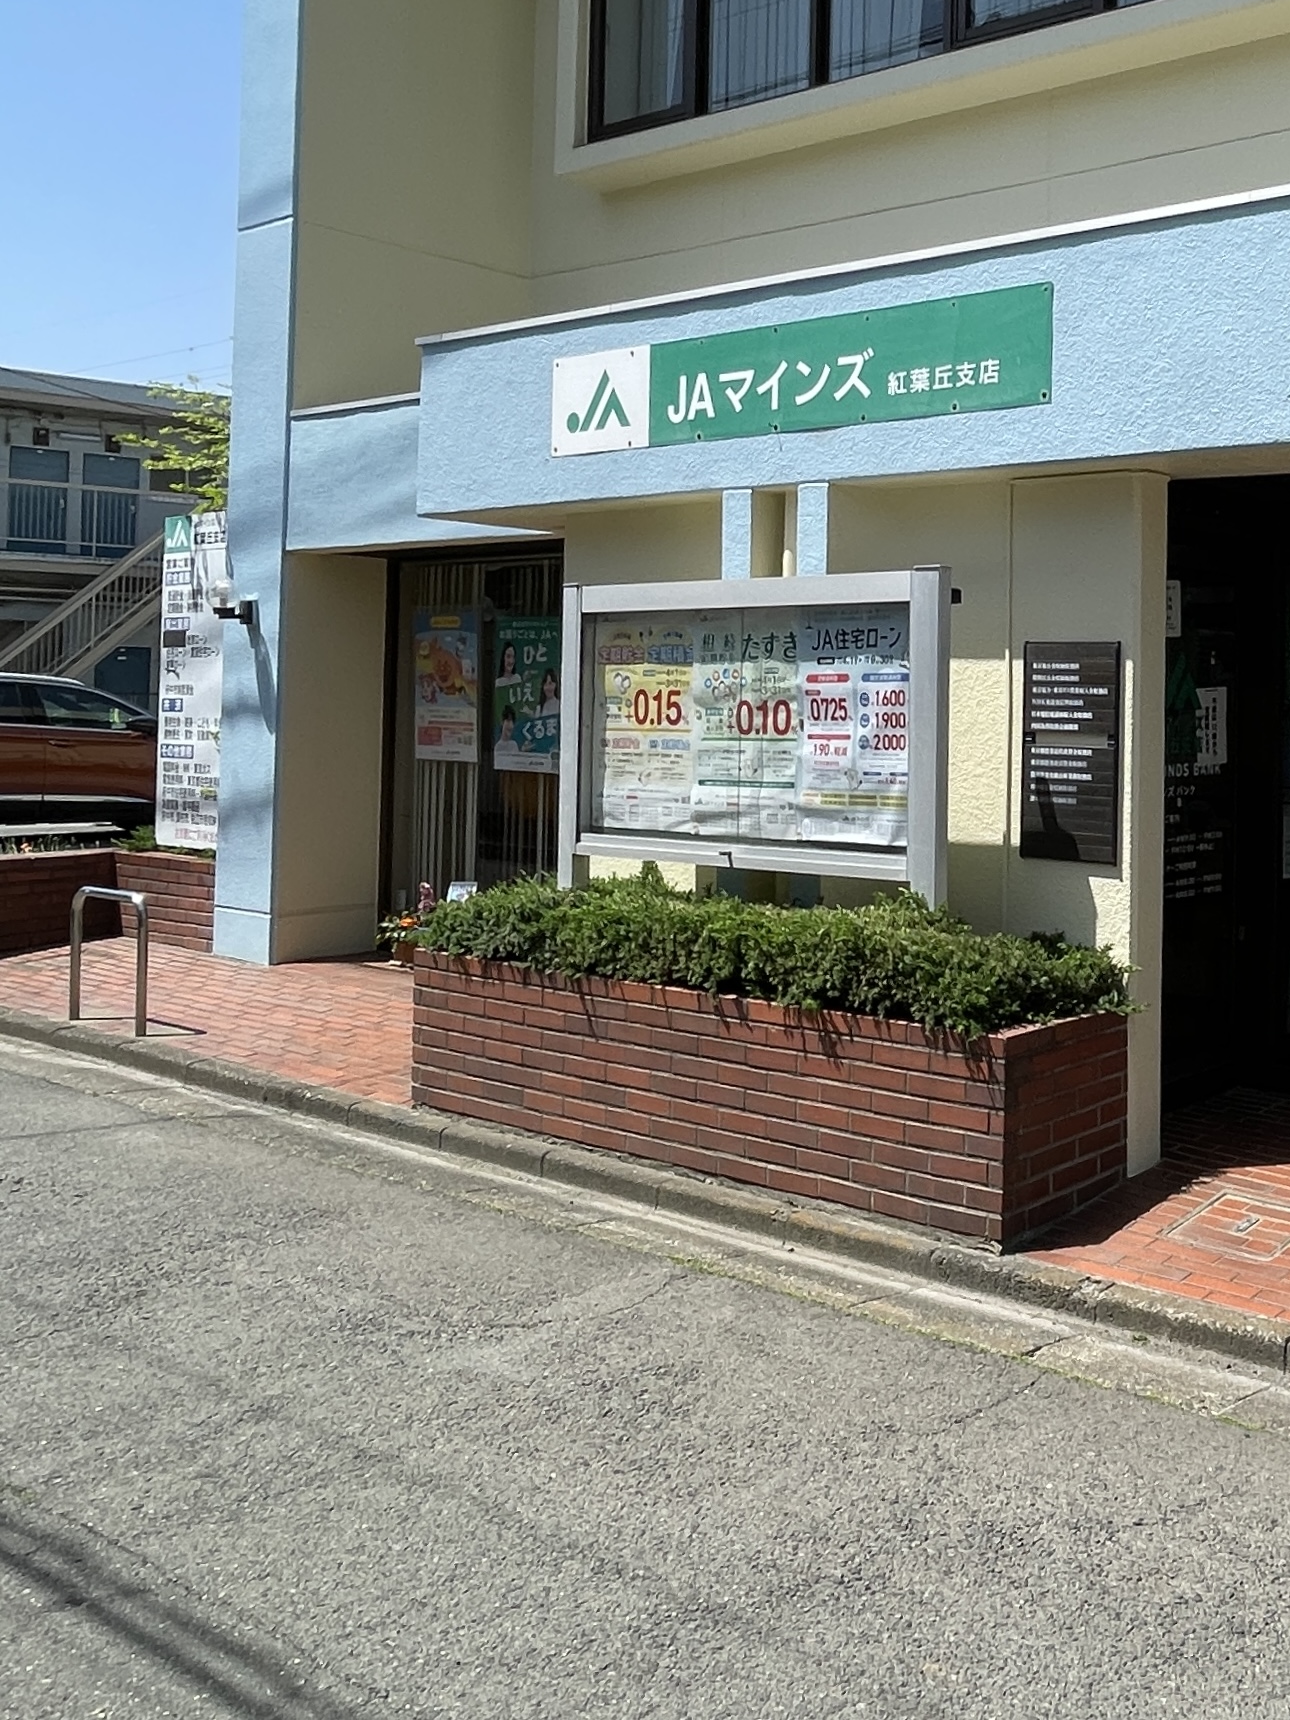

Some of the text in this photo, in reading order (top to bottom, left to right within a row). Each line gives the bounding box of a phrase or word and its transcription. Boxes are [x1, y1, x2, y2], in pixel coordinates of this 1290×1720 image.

[668, 347, 1000, 424] JAマインズ 紅葉丘支店
[742, 631, 797, 663] たすき
[812, 627, 902, 651] JA住宅ローン
[523, 643, 548, 665] ひと
[509, 683, 534, 704] いえ
[522, 719, 557, 740] くるま
